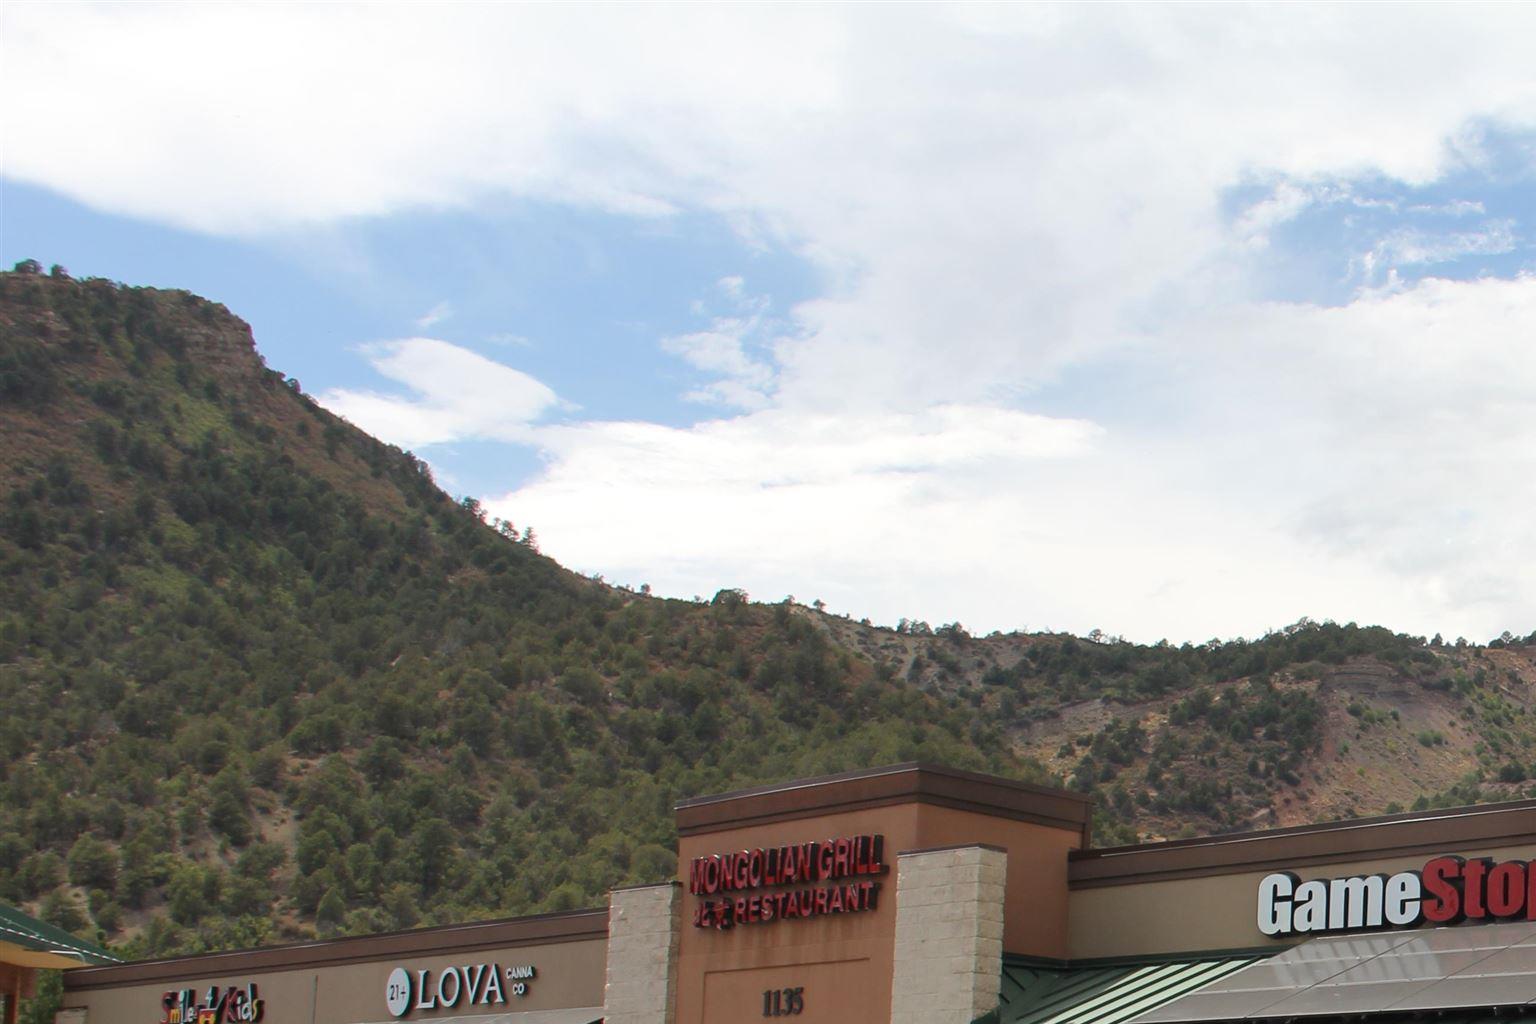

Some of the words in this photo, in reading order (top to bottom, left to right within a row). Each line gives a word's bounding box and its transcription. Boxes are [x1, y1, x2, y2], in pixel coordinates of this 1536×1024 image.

[690, 843, 818, 895] MONGOLIAN
[818, 834, 885, 881] GRILL
[734, 881, 875, 924] RESTAURANT
[415, 963, 505, 1009] LOVA
[505, 965, 534, 980] CANNA
[512, 982, 526, 995] CO
[226, 983, 263, 1023] Kids
[389, 984, 406, 1001] 21+
[762, 987, 805, 1018] 1135
